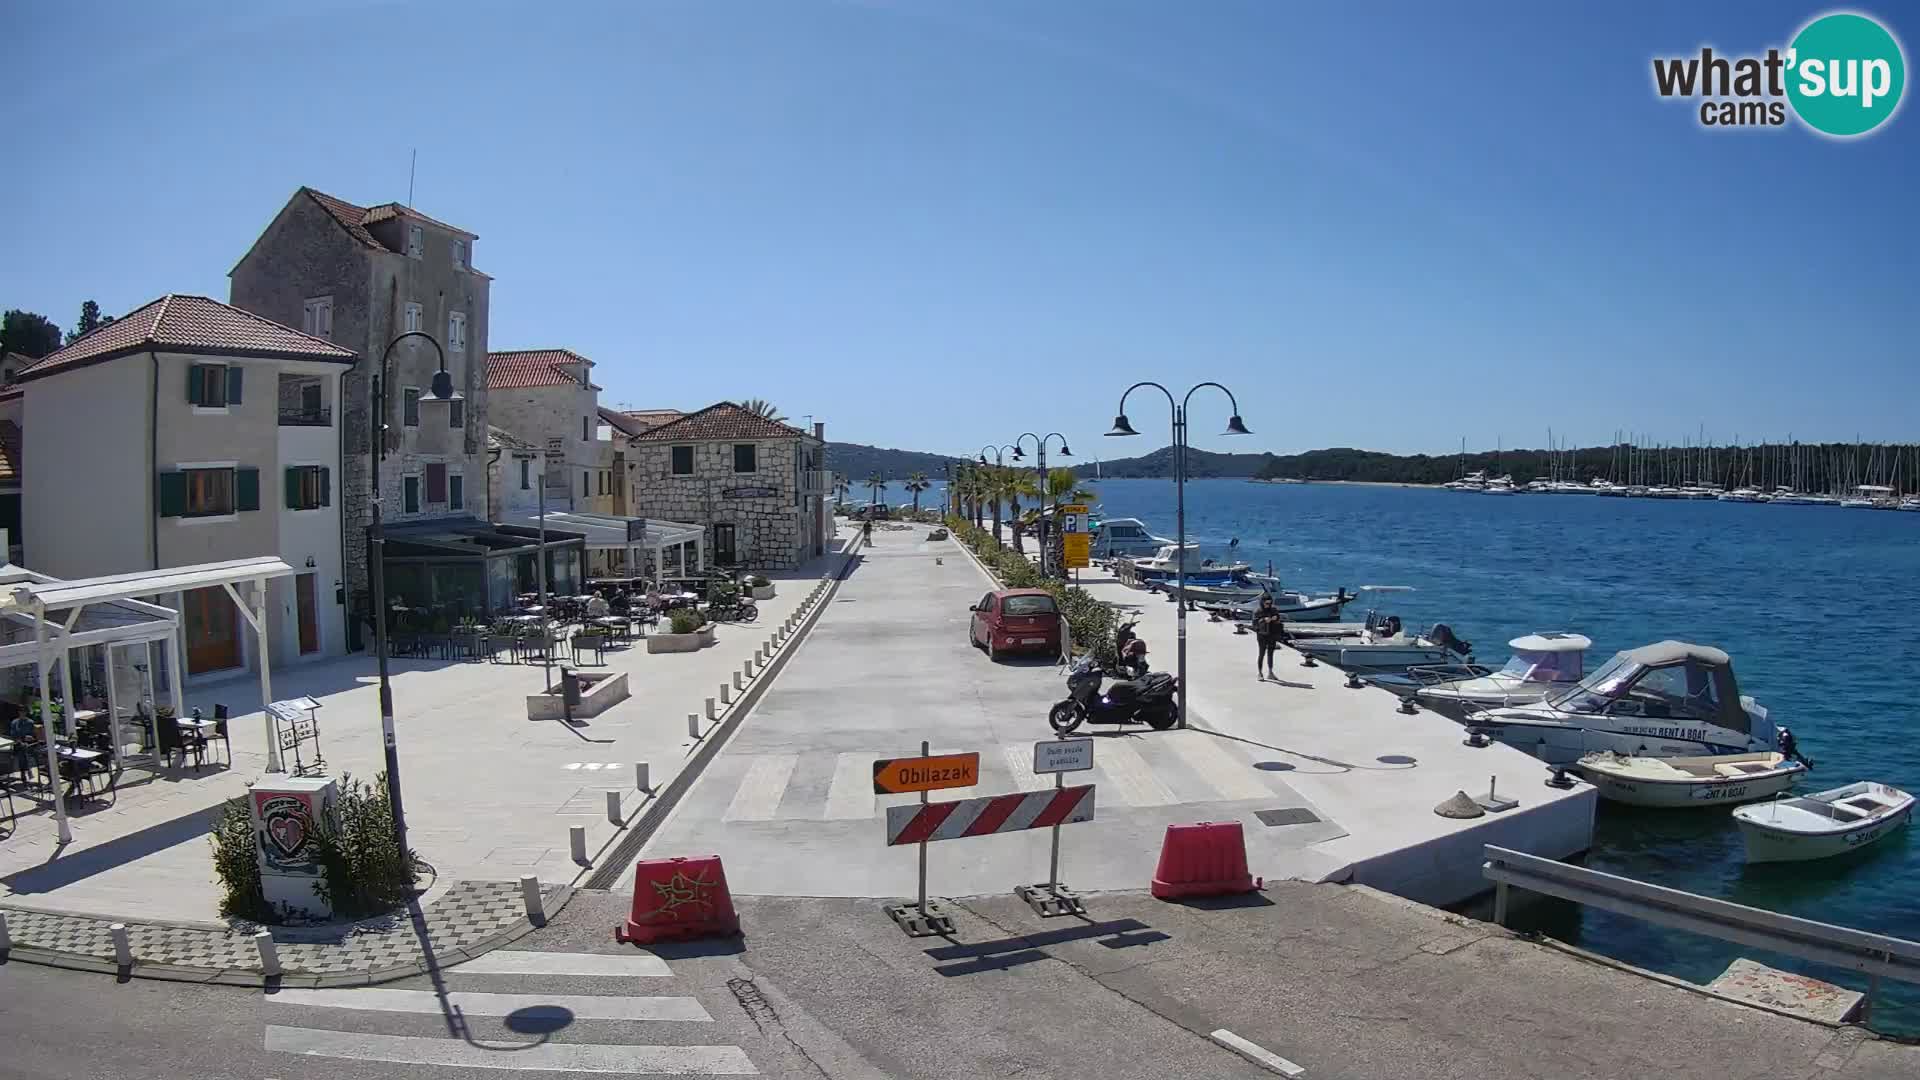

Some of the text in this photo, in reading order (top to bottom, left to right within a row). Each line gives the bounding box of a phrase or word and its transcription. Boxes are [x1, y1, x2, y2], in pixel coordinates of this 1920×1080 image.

[1658, 727, 1680, 736] RENT
[1687, 728, 1707, 741] BOAT
[899, 766, 971, 785] Obilazak
